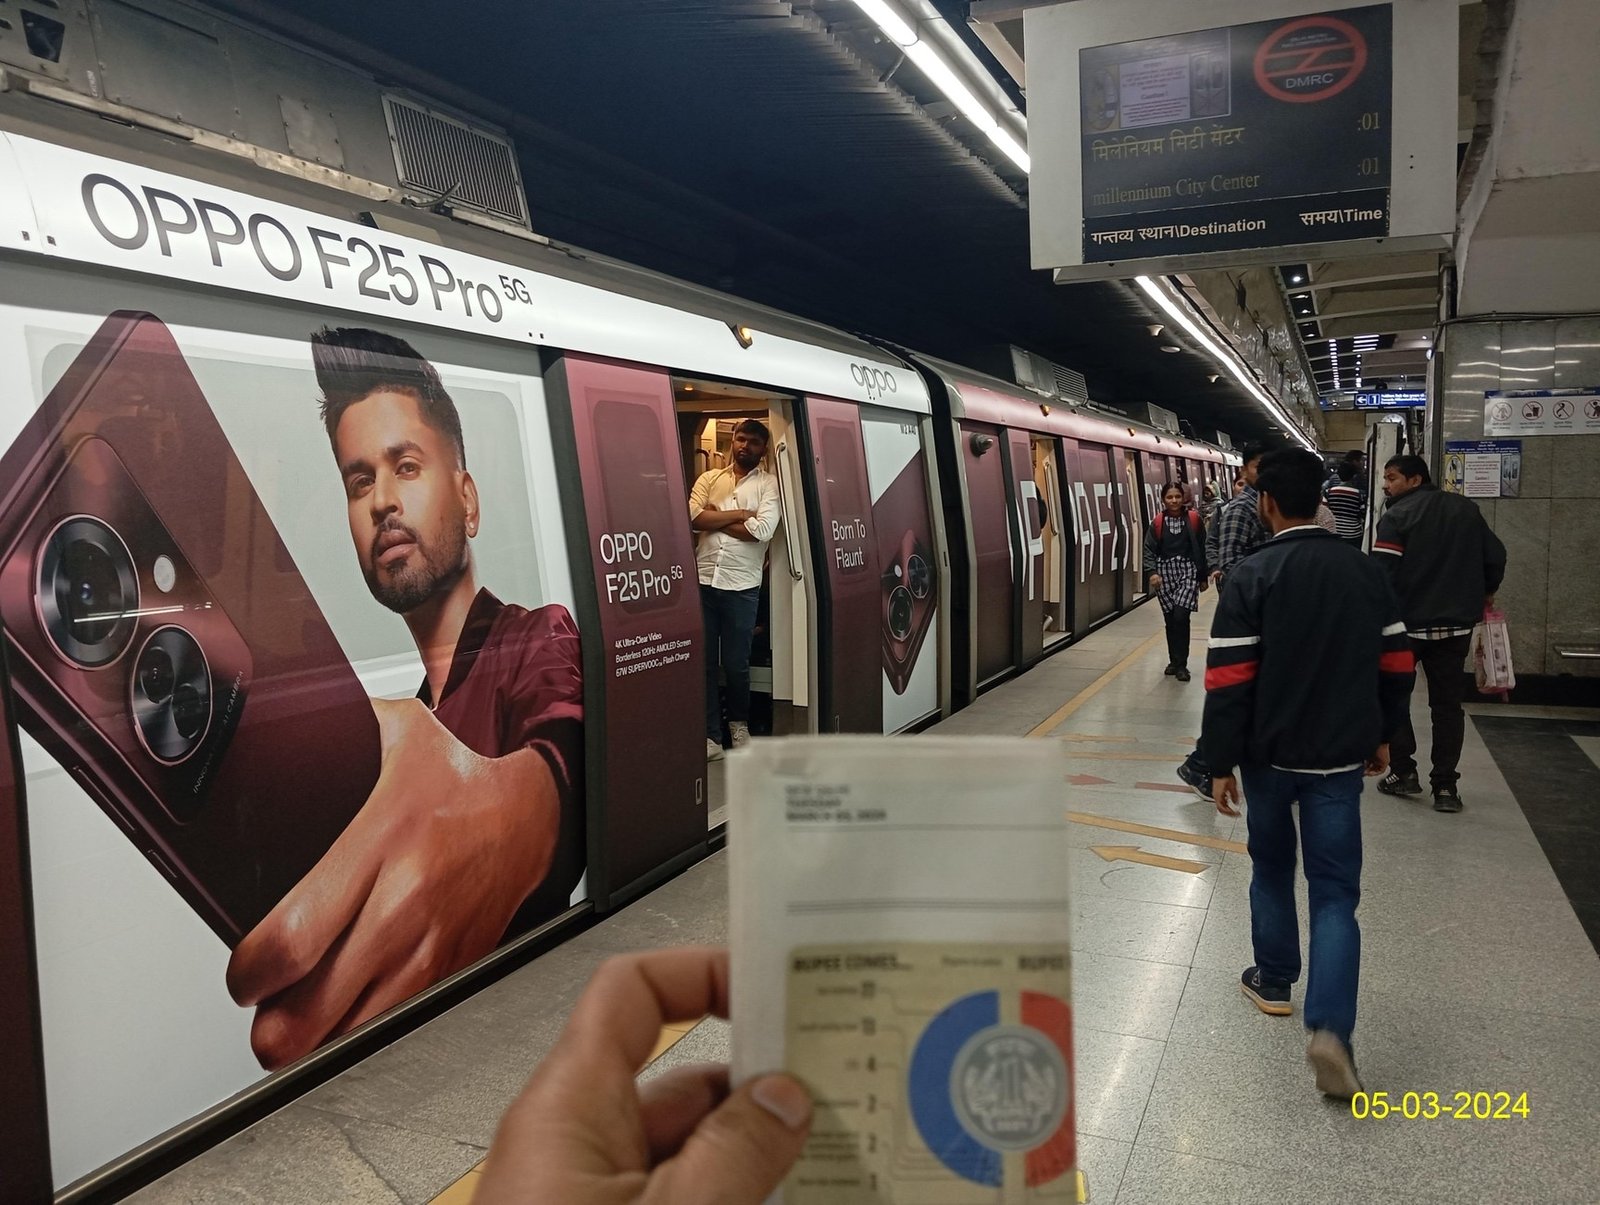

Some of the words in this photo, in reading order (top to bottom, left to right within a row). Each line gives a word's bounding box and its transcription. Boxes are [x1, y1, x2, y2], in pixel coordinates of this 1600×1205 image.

[1285, 73, 1334, 89] DMRC
[1092, 134, 1166, 162] मिलेनियम
[1169, 126, 1206, 153] सिटी
[1209, 124, 1246, 147] सेंटर
[1092, 183, 1172, 206] millennium
[1175, 177, 1207, 198] City
[1211, 174, 1261, 192] Center
[81, 173, 302, 282] OPPO
[307, 227, 419, 306] F25
[420, 255, 503, 323] Pro
[501, 275, 533, 306] 5G
[1091, 229, 1135, 246] गन्तव्य
[831, 520, 854, 541] Born
[854, 519, 866, 539] To
[600, 531, 653, 564] OPPO
[835, 547, 864, 569] Flaunt
[605, 570, 641, 604] F25
[642, 569, 671, 598] Pro
[671, 565, 683, 580] 5G
[648, 633, 663, 641] Video
[615, 651, 641, 664] Borderless
[656, 641, 677, 653] AMOLED
[676, 639, 692, 648] Screen
[674, 652, 690, 661] Charge
